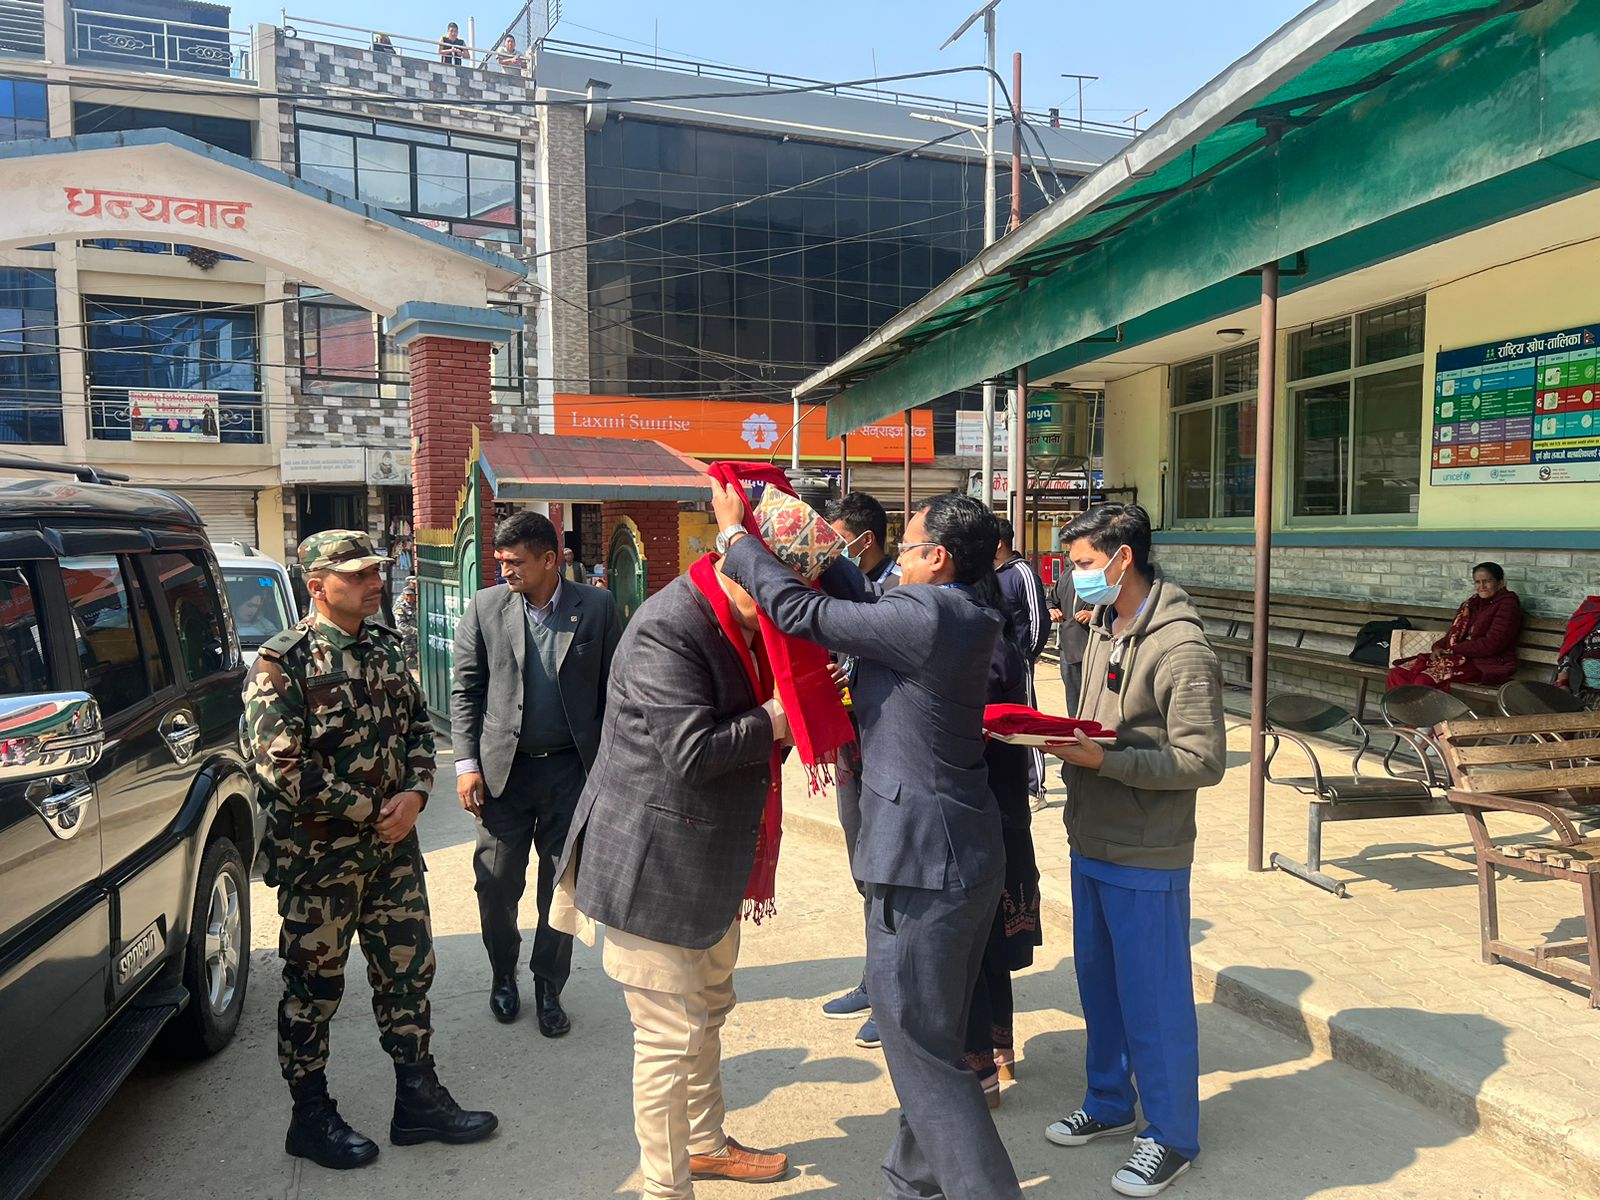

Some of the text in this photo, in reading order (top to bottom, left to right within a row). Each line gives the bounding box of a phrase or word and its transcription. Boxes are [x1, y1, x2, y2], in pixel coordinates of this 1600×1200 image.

[63, 187, 252, 232] धन्यवाद
[571, 411, 691, 431] Laxmi Sunrise
[1443, 472, 1463, 481] unicef
